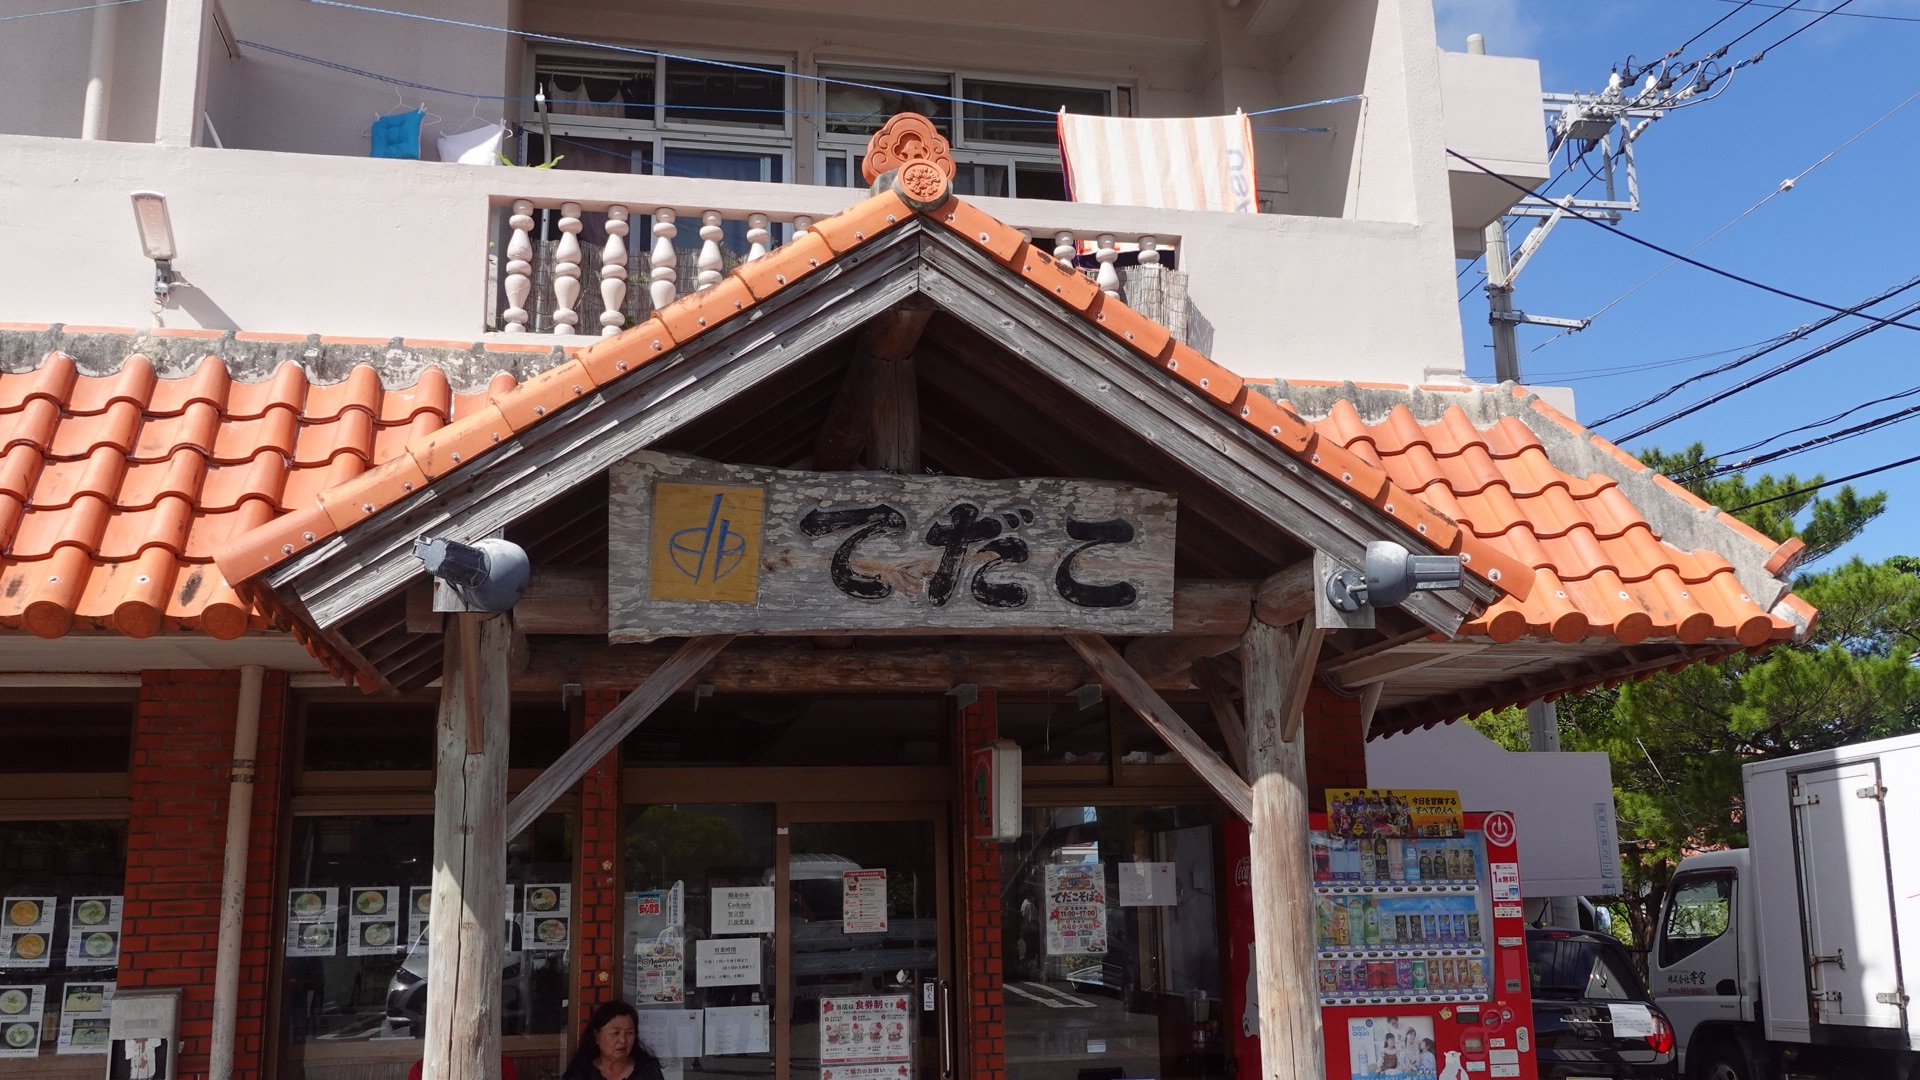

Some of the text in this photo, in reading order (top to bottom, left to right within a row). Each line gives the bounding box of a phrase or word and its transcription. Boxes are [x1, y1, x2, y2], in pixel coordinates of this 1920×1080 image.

[799, 501, 1137, 609] てだこ
[1412, 797, 1457, 806] 今日を冒険する
[1051, 890, 1098, 904] てだこそば
[649, 957, 680, 965] Instagram
[925, 984, 934, 1000] 引く
[836, 999, 895, 1011] 当店は食券制です
